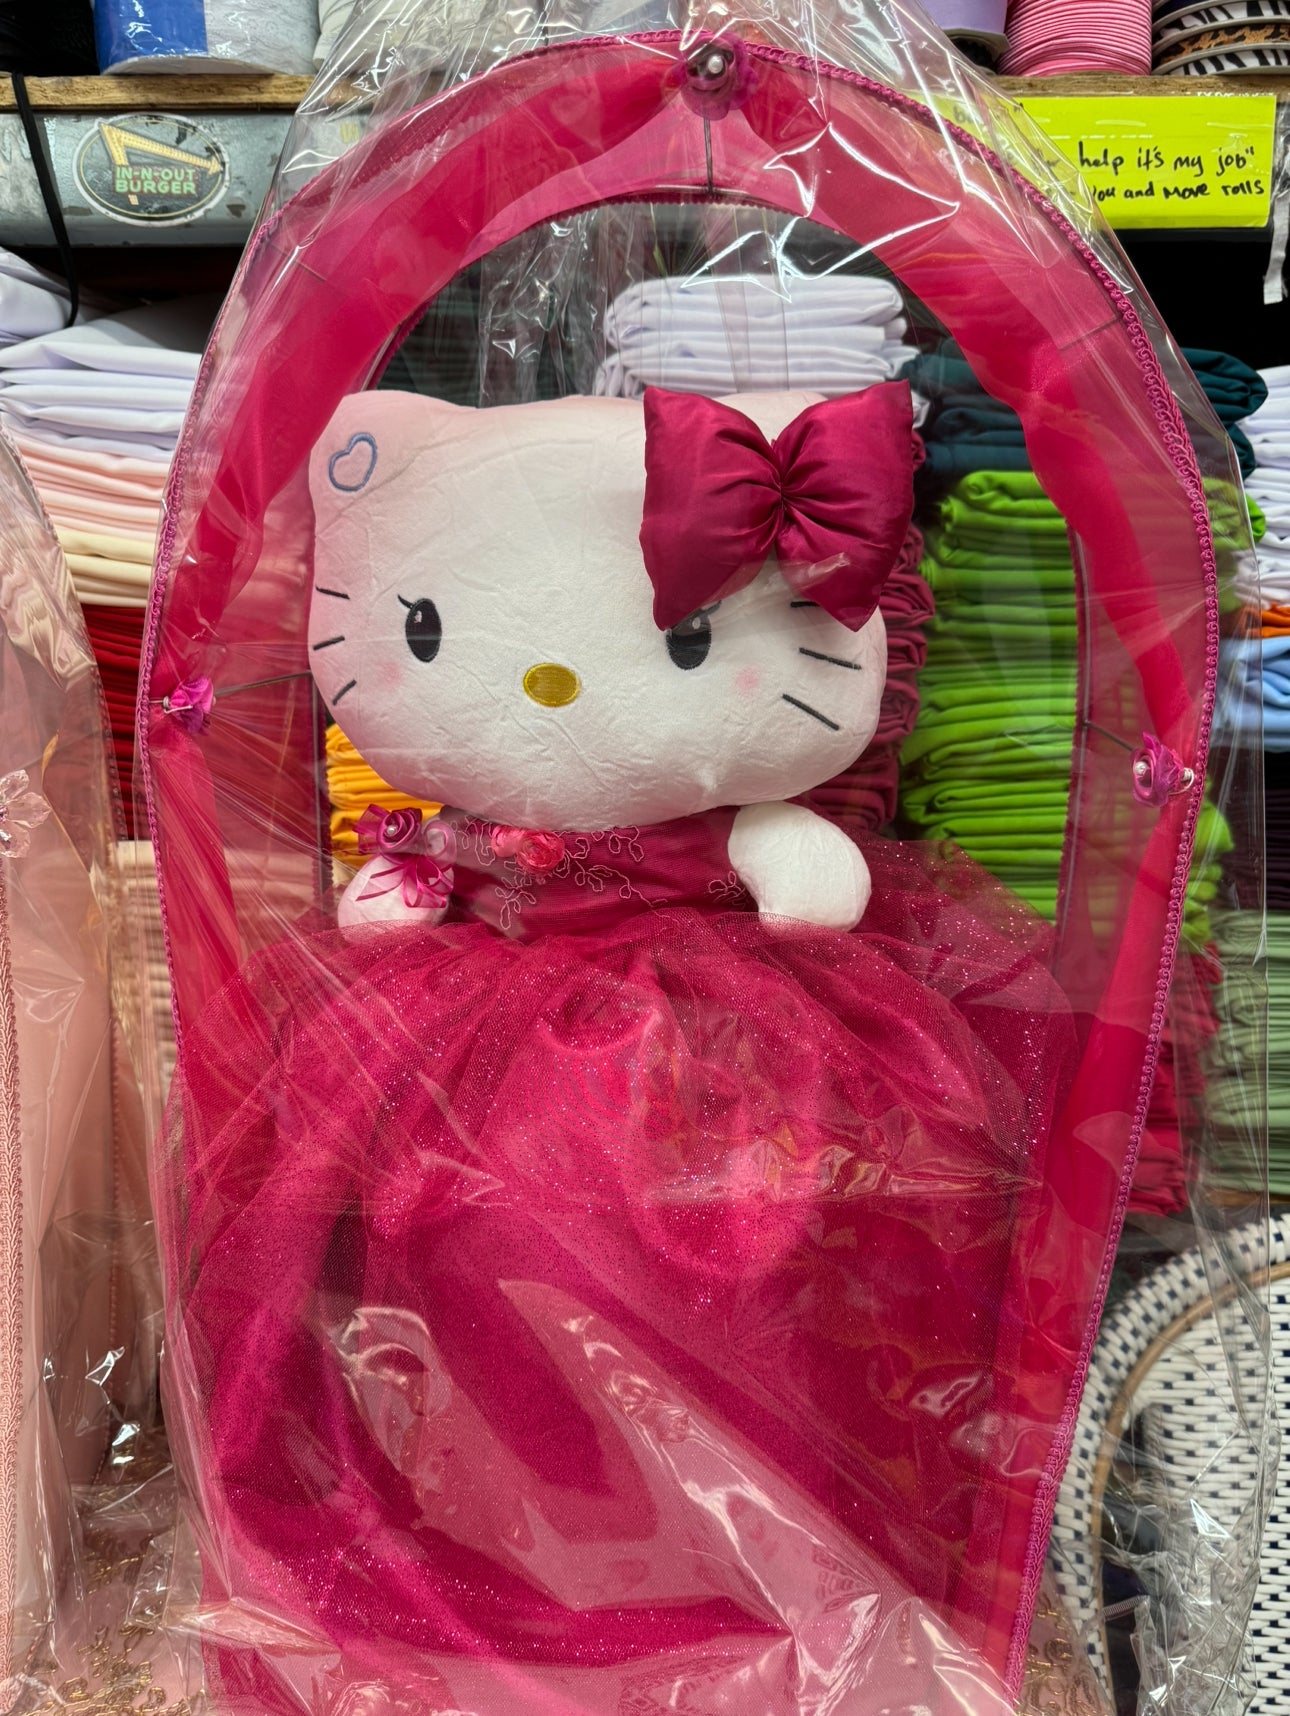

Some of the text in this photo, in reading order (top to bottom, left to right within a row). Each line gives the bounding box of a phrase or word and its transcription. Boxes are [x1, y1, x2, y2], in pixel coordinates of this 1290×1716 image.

[1079, 141, 1124, 176] help
[1137, 146, 1164, 171] it's
[1174, 155, 1204, 177] my
[116, 167, 196, 181] IN-N-OUT
[115, 180, 196, 194] BURGER
[1124, 181, 1155, 199] and
[1221, 180, 1264, 196] rolls
